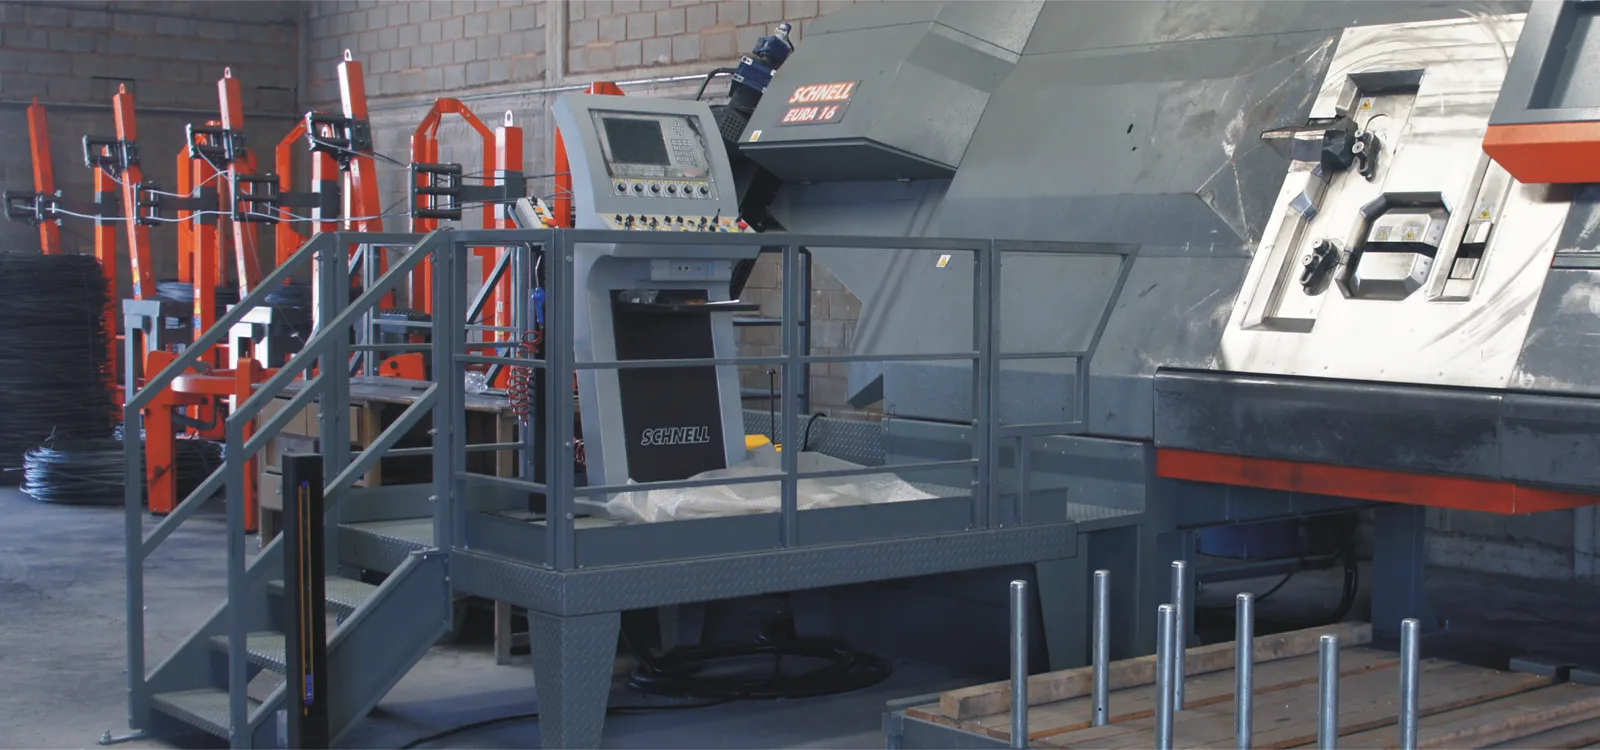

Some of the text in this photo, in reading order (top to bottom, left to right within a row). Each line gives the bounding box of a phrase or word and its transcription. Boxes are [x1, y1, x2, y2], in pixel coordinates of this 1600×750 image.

[788, 82, 856, 103] SCHNELL
[782, 105, 838, 122] EURA 16
[641, 426, 710, 446] SCHNELL
